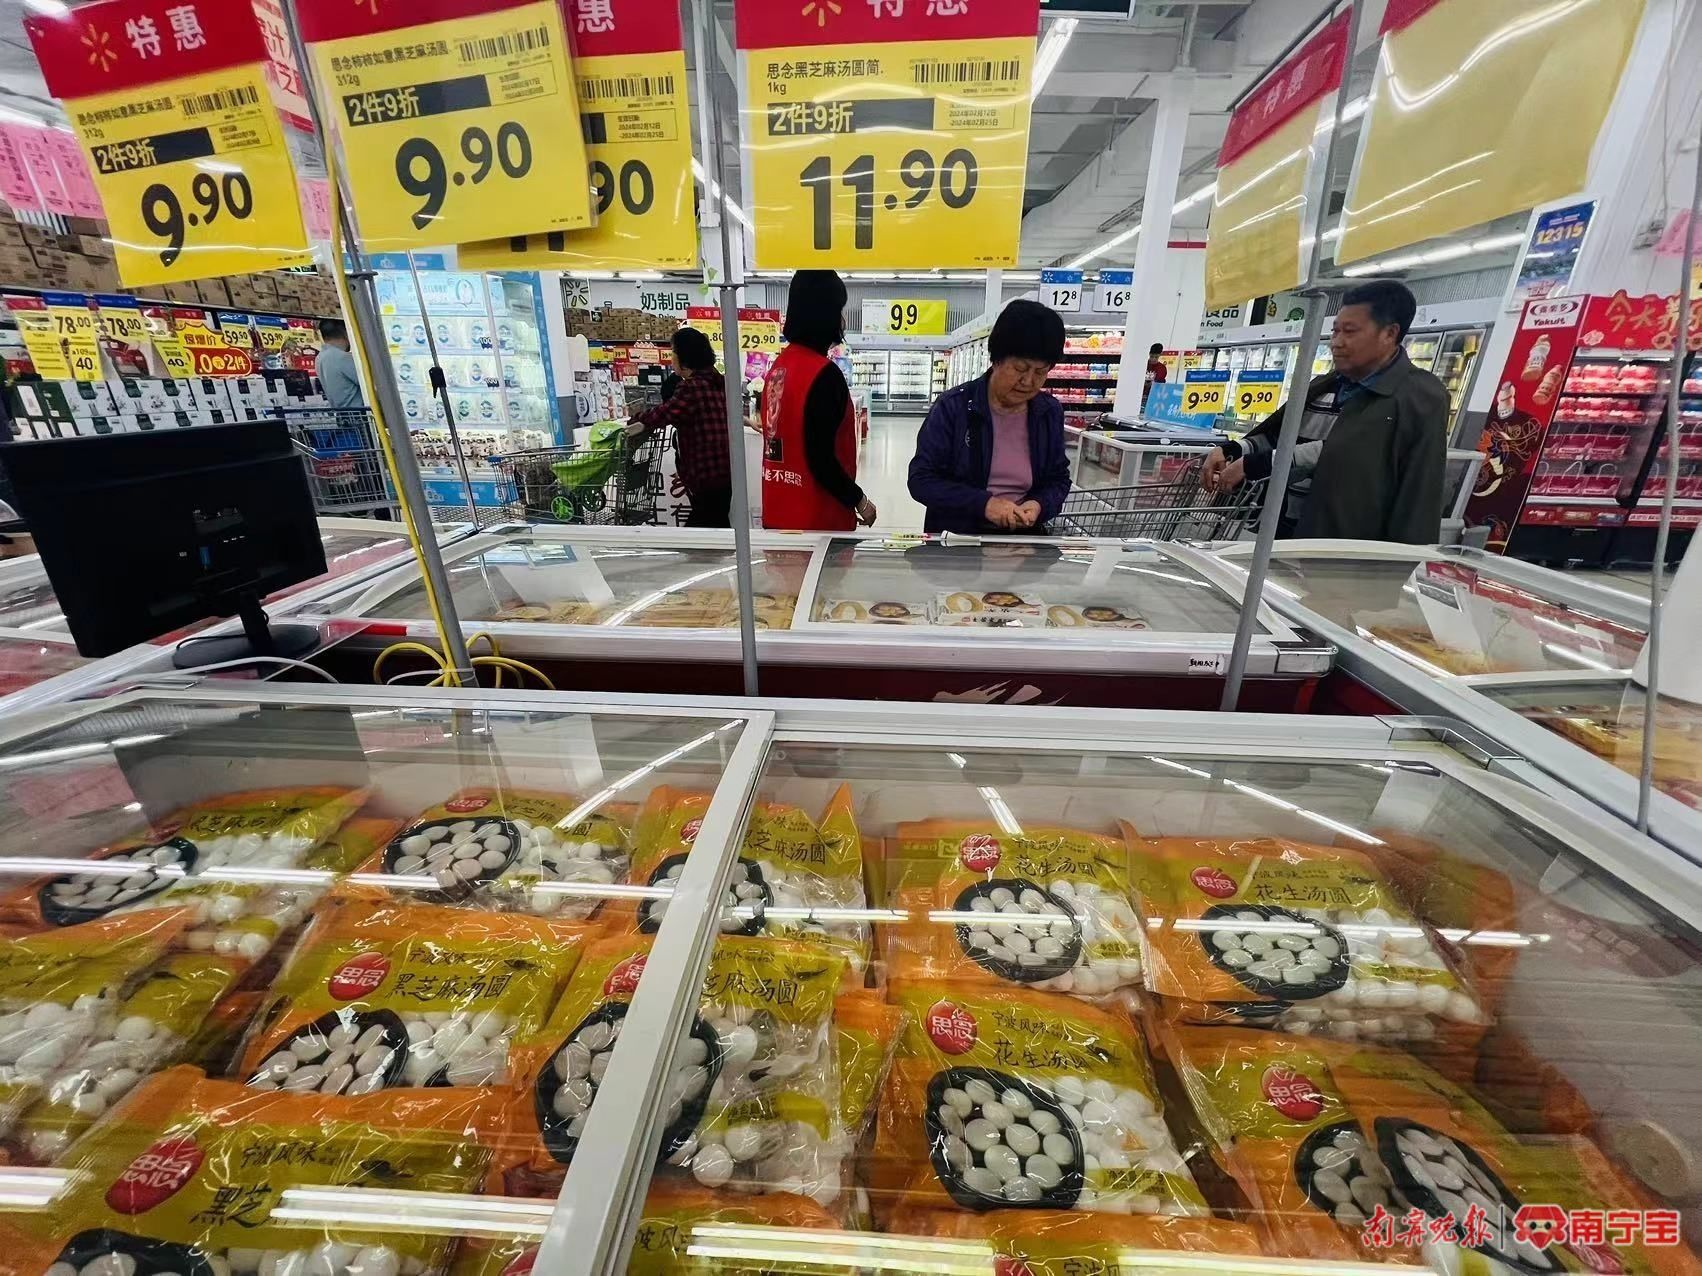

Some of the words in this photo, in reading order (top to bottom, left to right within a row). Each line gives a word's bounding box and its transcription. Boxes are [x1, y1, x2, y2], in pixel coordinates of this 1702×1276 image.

[124, 4, 208, 60] 特惠
[335, 72, 361, 87] 312g
[767, 81, 787, 95] 1kg
[348, 87, 420, 124] 2件9折
[771, 101, 854, 134] 2件9折
[83, 127, 105, 139] 312g
[96, 138, 158, 172] 2件9折
[394, 120, 533, 231] 9.90
[799, 148, 978, 250] 11.90
[141, 172, 253, 267] 9.90
[1536, 221, 1585, 245] 12315
[639, 291, 691, 311] 奶制品
[54, 316, 91, 334] 78.00
[106, 317, 142, 337] 78.00
[1533, 317, 1566, 326] Yakult
[741, 334, 776, 349] 29.90
[1187, 391, 1219, 410] 9.90
[1240, 391, 1273, 411] 9.90
[1254, 883, 1353, 904] 花生汤圆
[385, 972, 513, 1001] 黑芝麻汤圆
[931, 1015, 973, 1038] 思念
[122, 1153, 191, 1190] 思念
